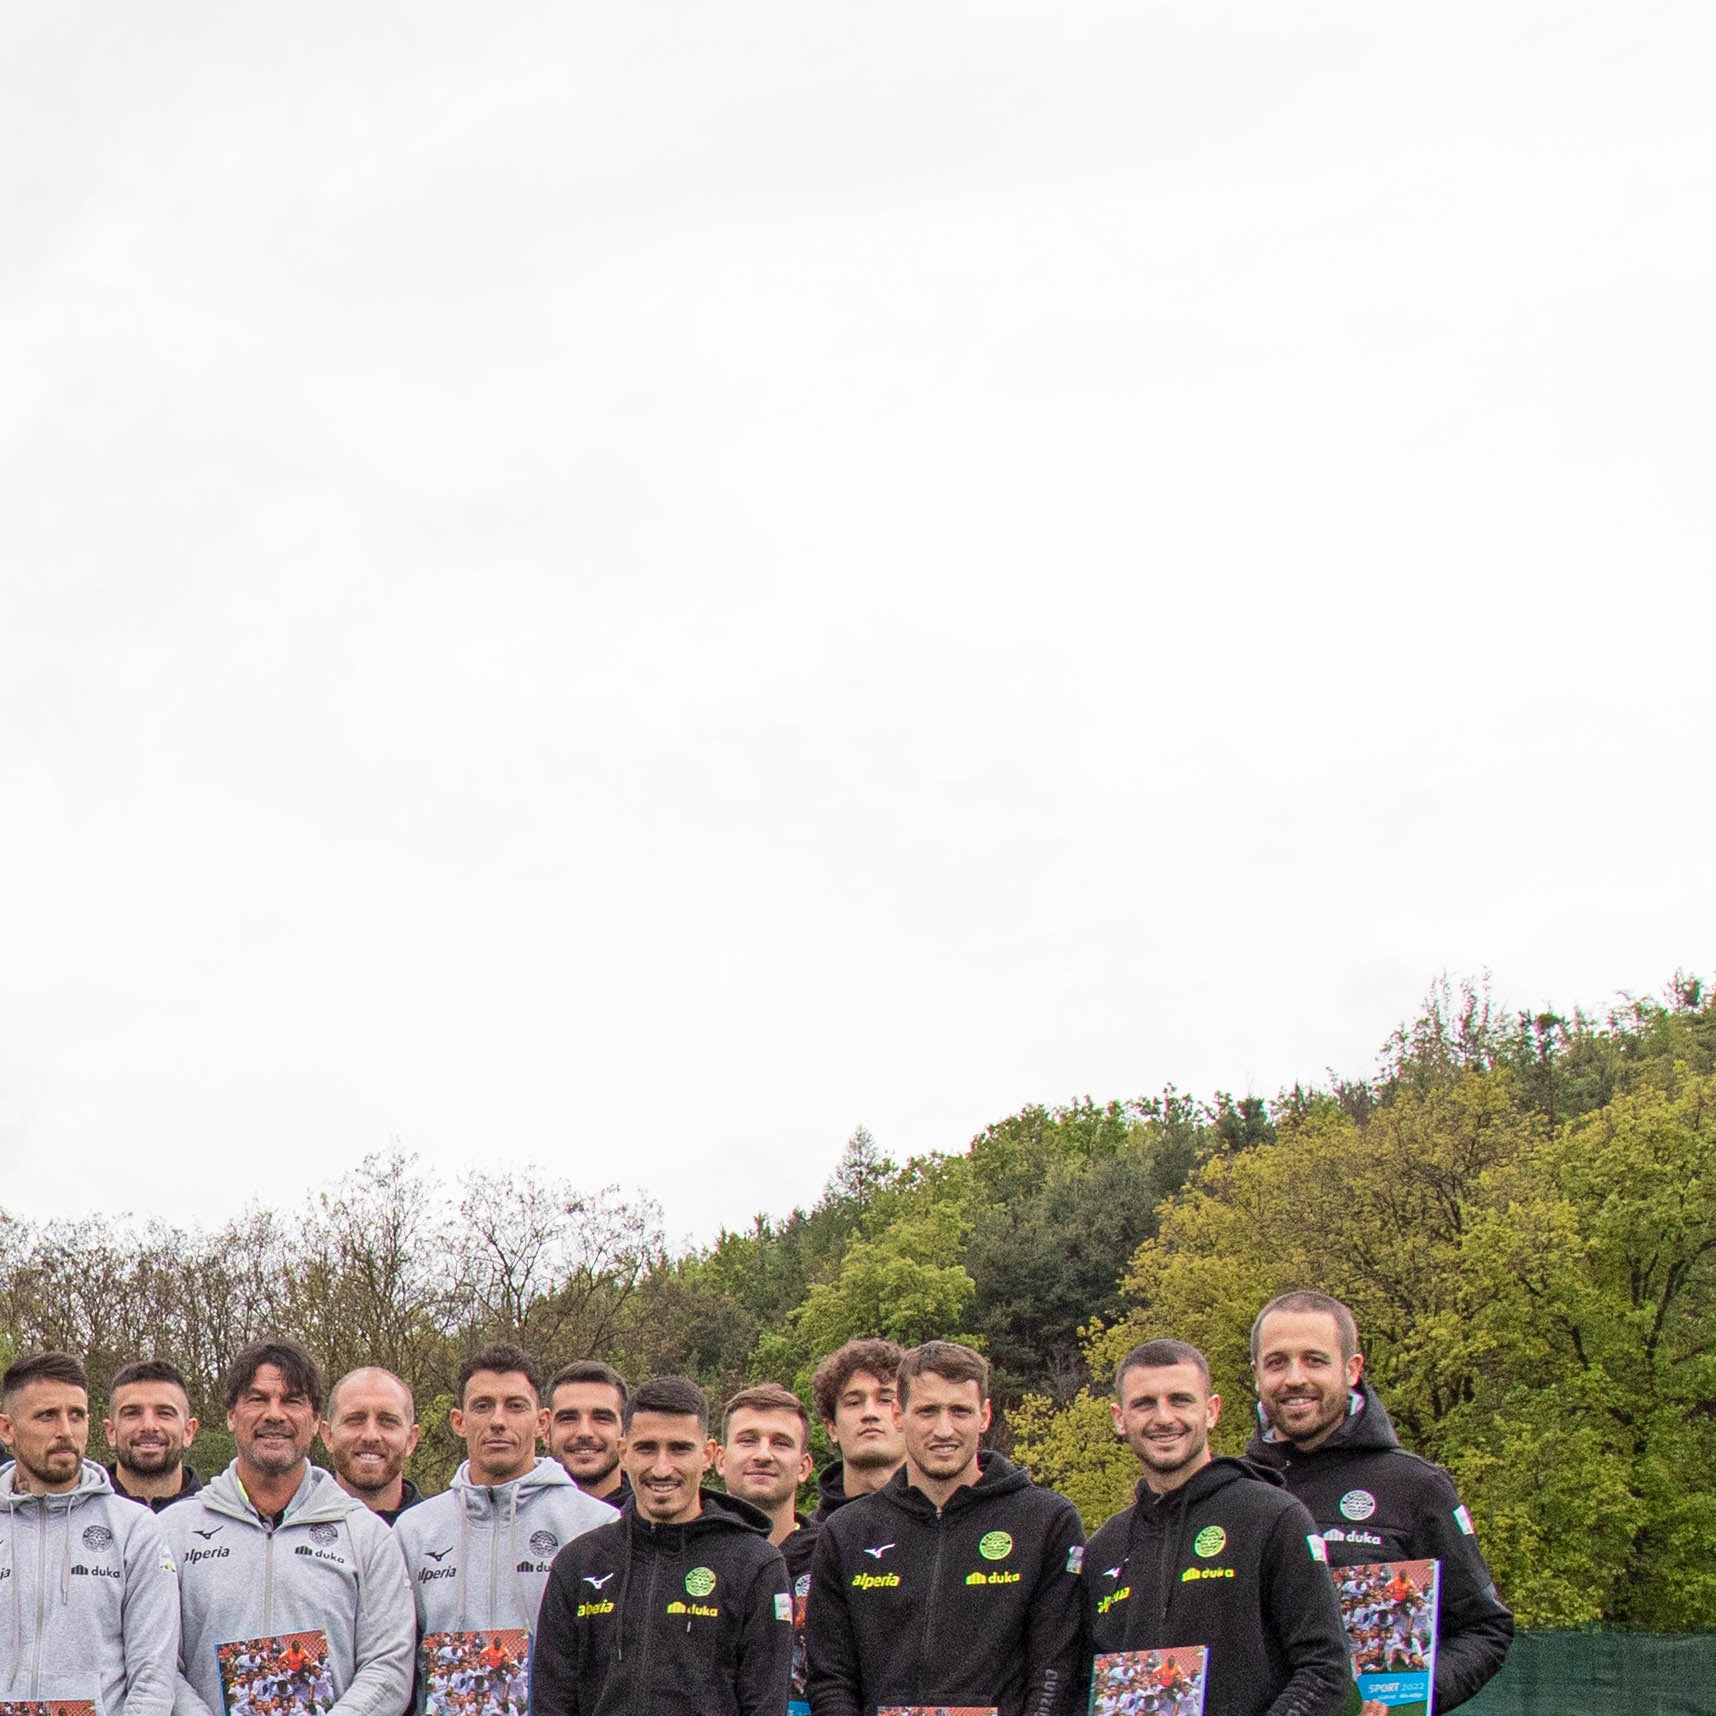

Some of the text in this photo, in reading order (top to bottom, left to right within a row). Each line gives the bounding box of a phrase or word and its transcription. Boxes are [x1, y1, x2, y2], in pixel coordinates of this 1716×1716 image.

[1346, 1530, 1384, 1545] duka
[315, 1549, 345, 1564] duka
[91, 1565, 121, 1579] duka
[987, 1571, 1022, 1585] duka
[851, 1572, 902, 1591] alperia
[1368, 1683, 1400, 1693] SPORT
